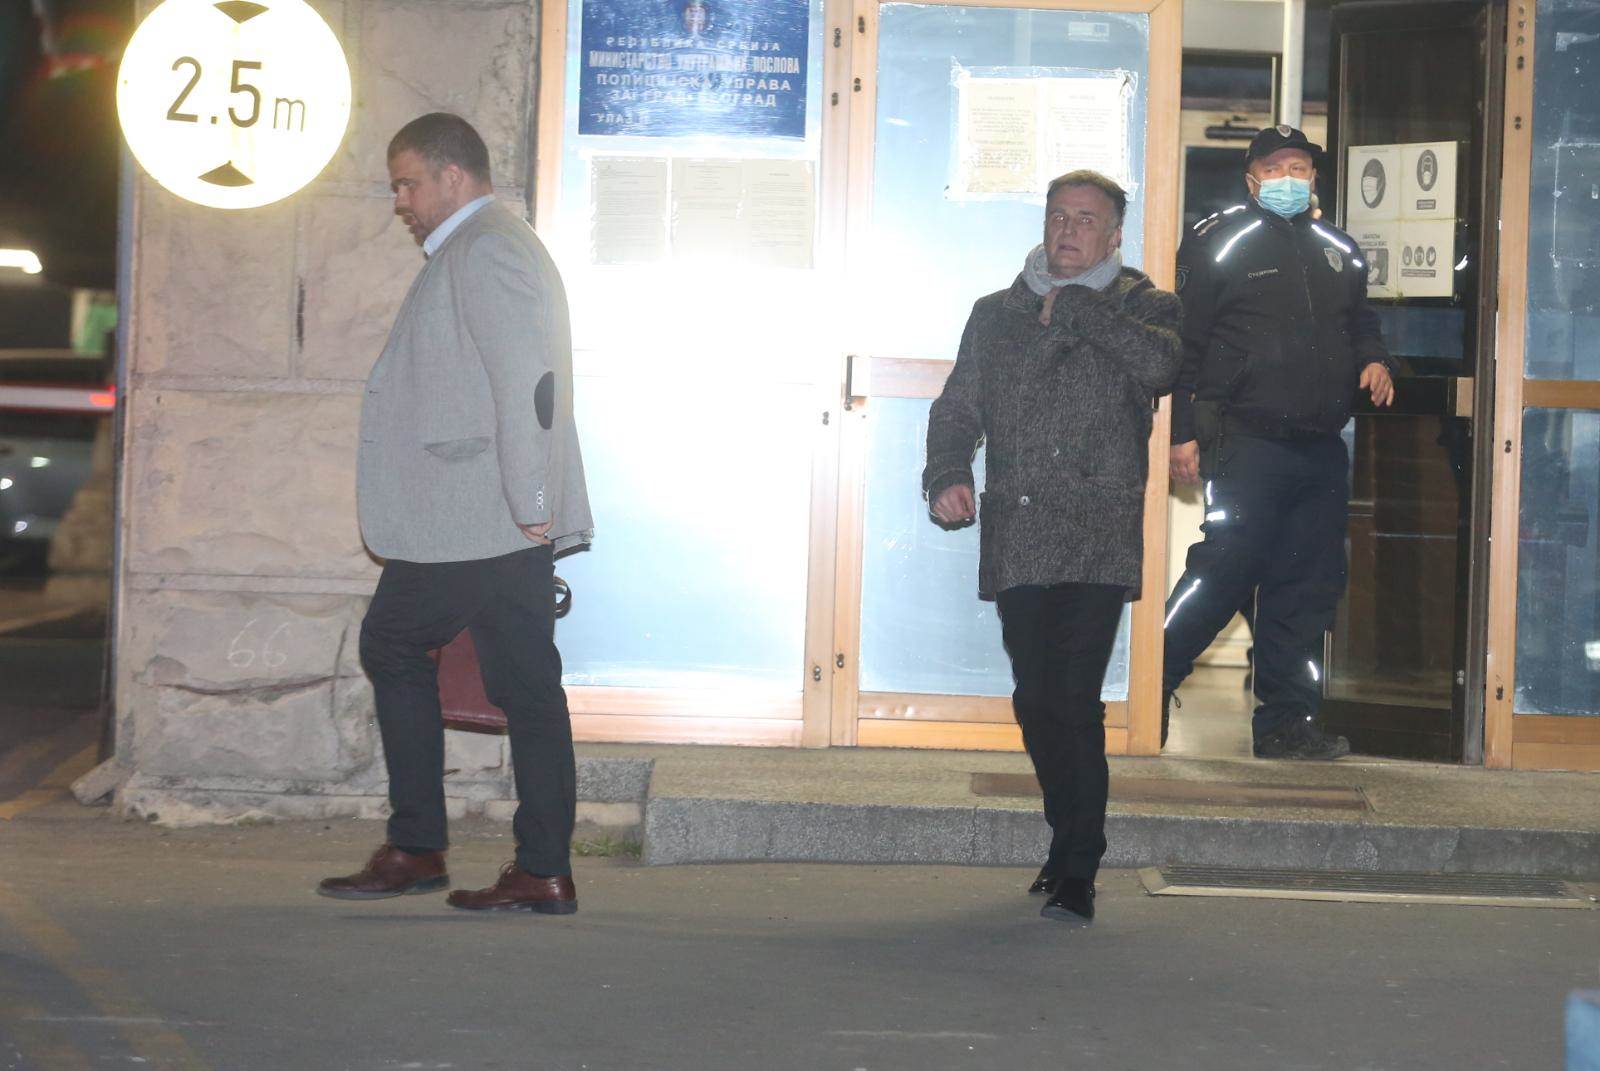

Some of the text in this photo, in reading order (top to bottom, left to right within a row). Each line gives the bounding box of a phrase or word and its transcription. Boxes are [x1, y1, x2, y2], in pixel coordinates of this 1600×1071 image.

[715, 40, 781, 52] СРБИЈА
[752, 56, 800, 74] ПОСЛОВА
[596, 73, 792, 91] ПОЛИЦИЈСКА УПРАВА
[166, 55, 306, 132] 2.5 m
[226, 618, 289, 668] 66
